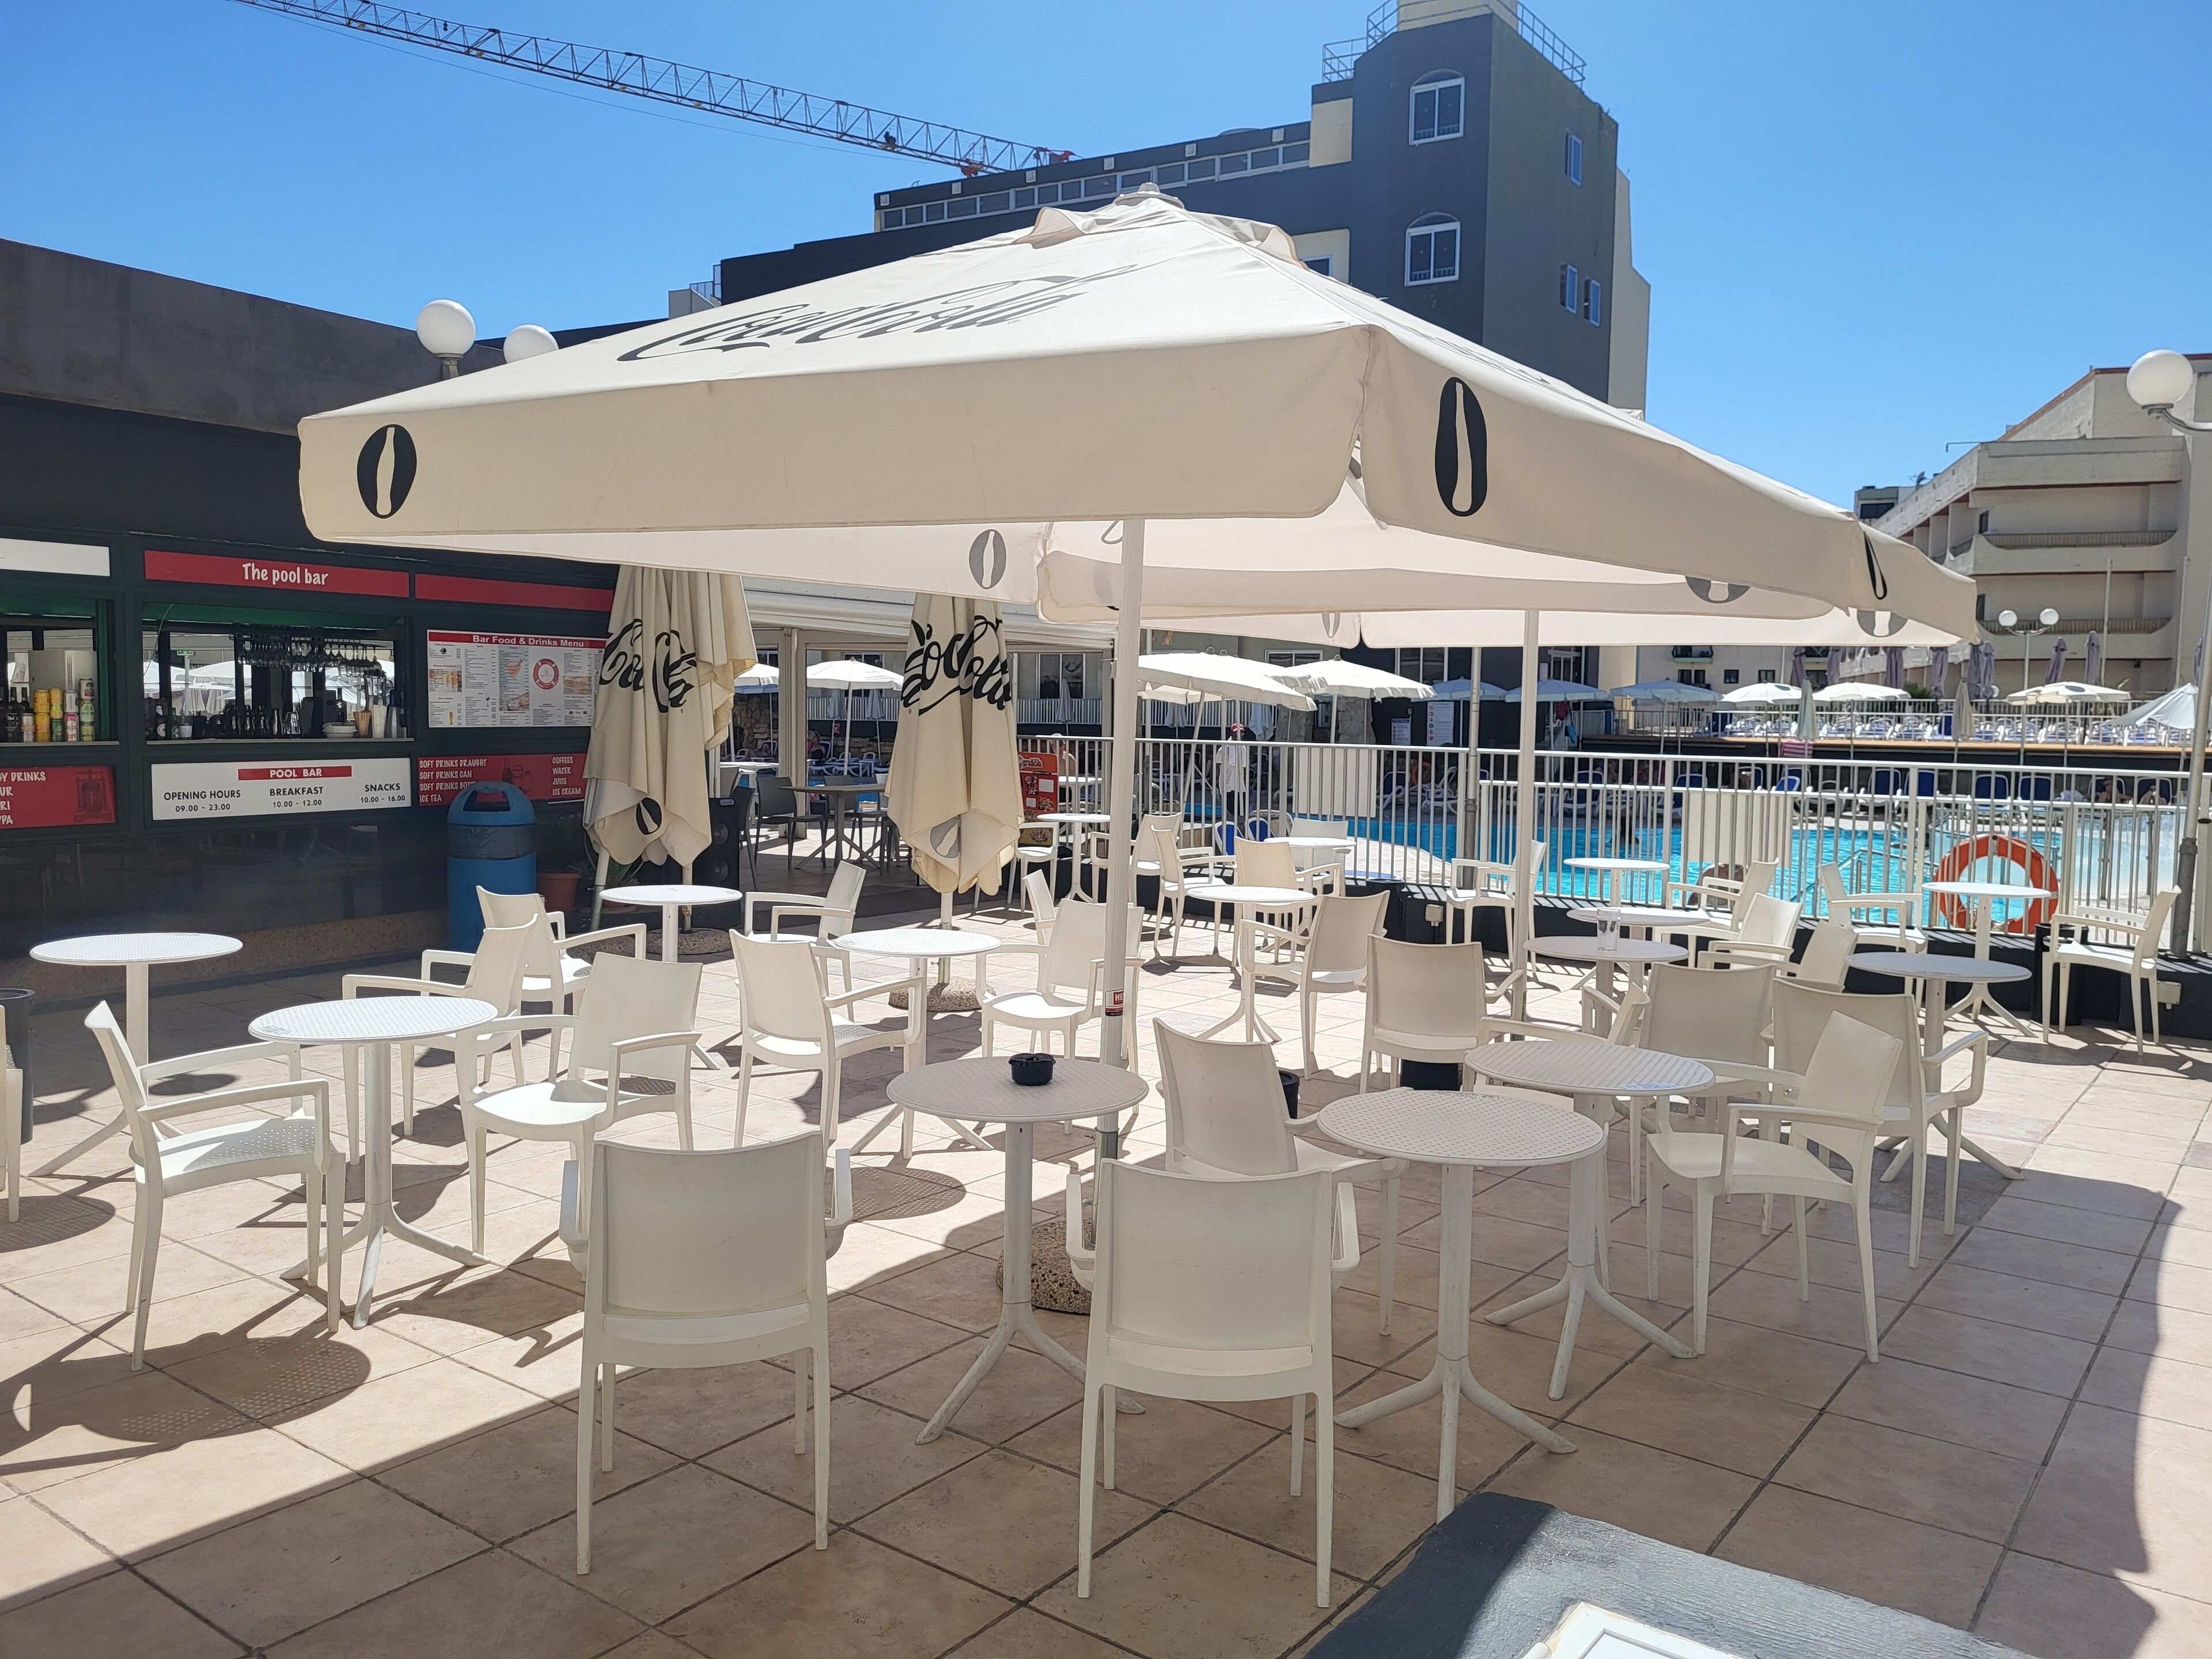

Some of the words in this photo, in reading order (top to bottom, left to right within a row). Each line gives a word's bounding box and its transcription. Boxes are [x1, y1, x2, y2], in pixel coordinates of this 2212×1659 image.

[242, 562, 268, 581] The
[272, 566, 301, 585] pool
[304, 568, 329, 585] bar
[472, 635, 490, 643] Bar
[492, 636, 516, 645] Food
[528, 638, 558, 646] Drinks
[419, 760, 434, 768] SOFT
[435, 759, 459, 768] DRINKS
[460, 759, 487, 767] DRAUGHT
[270, 769, 298, 778] POOL
[302, 768, 323, 777] BAR
[419, 771, 434, 780] SOFT
[435, 771, 459, 779] DRINKS
[459, 770, 472, 778] CAN
[552, 767, 571, 775] WATER
[11, 771, 46, 782] DRINKS
[270, 786, 324, 797] BREAKFAST
[364, 783, 400, 792] SNACKS
[419, 783, 434, 791] SOFT
[435, 782, 459, 790] DRINKS
[164, 791, 207, 801] OPENING
[210, 790, 241, 799] HOURS
[419, 794, 429, 802] ICE
[430, 794, 442, 802] TEA
